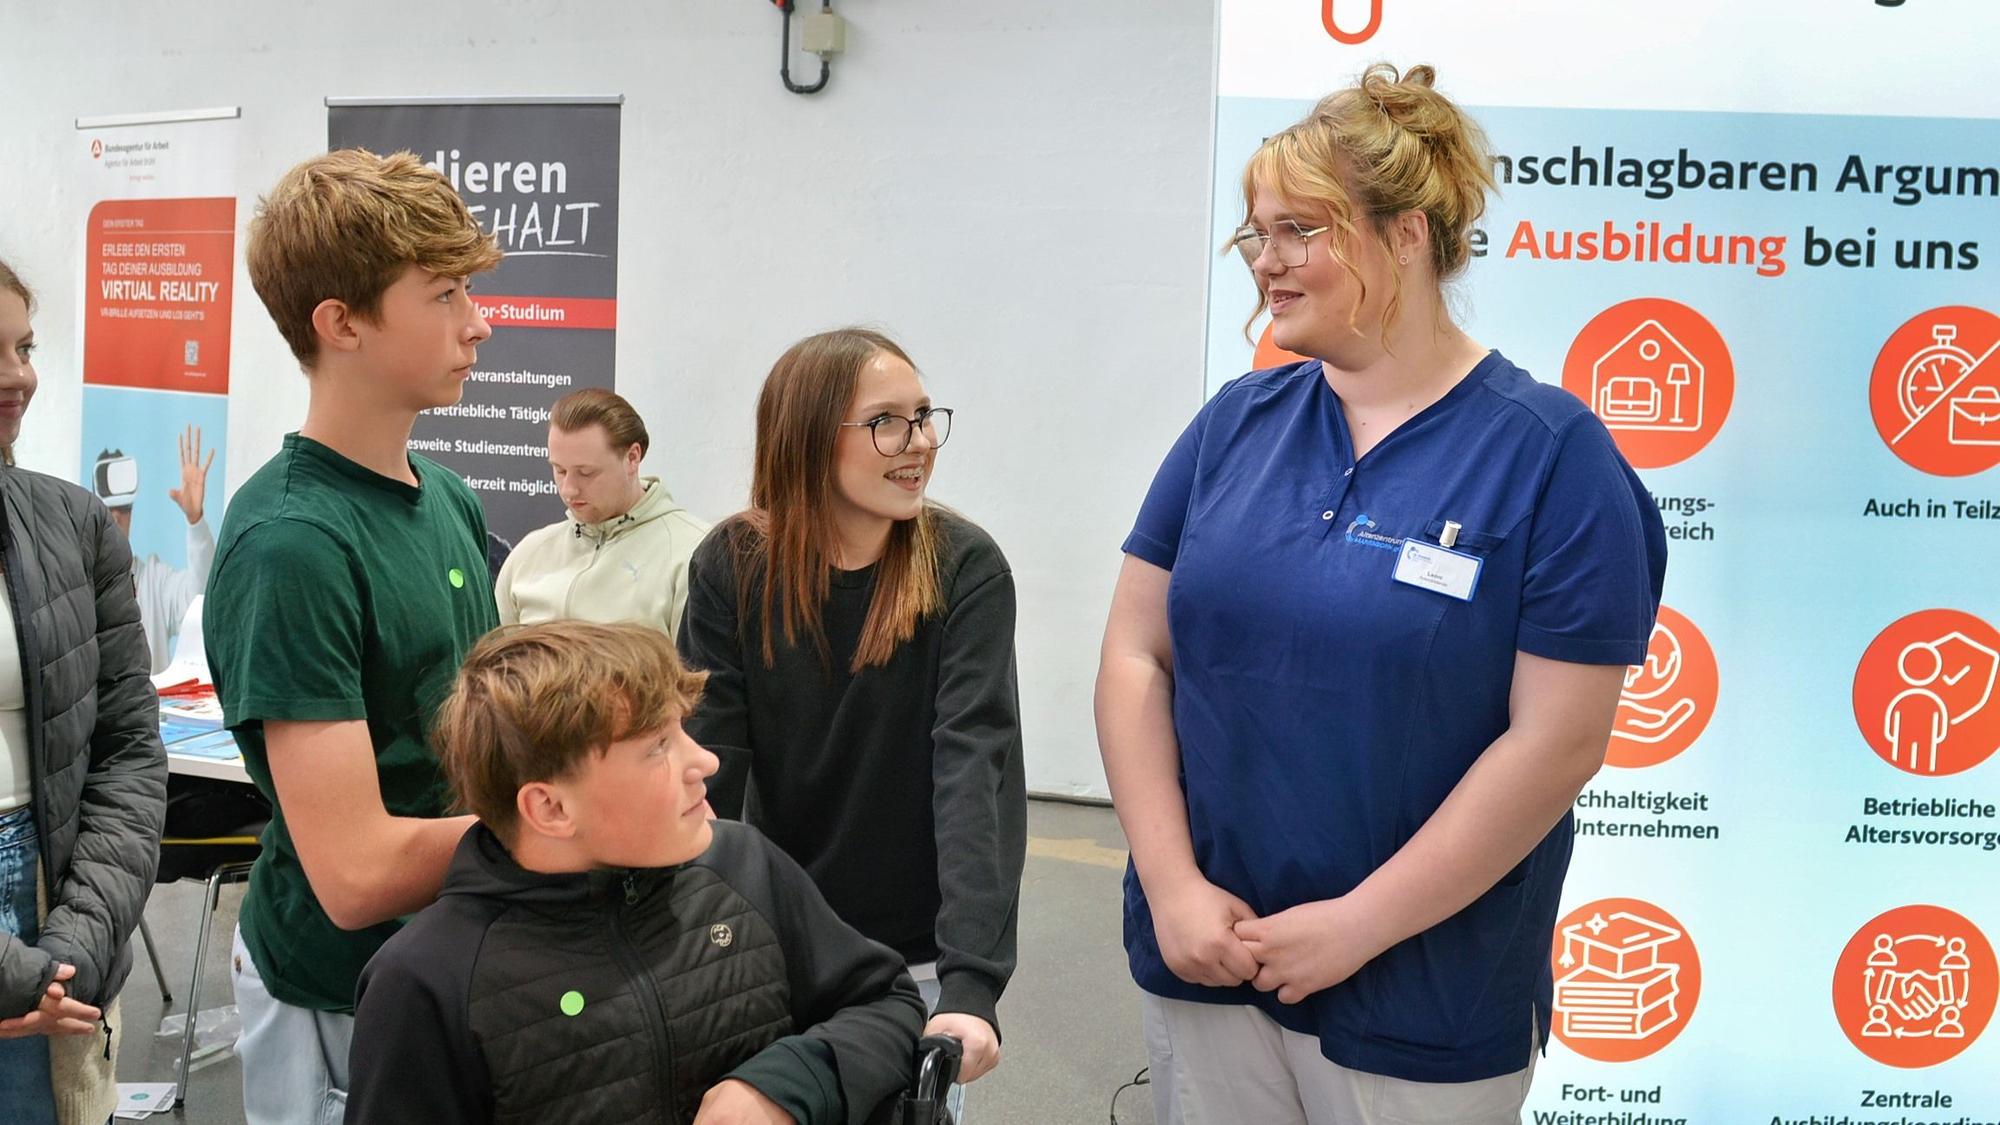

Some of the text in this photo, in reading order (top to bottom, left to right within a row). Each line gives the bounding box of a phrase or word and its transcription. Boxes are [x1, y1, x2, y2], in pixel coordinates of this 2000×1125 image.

[1835, 155, 2000, 206] Argum
[102, 243, 185, 257] ERLEBE DEN ERSTEN
[1505, 220, 1787, 277] Ausbildung
[1804, 226, 1876, 267] bei
[1895, 239, 1979, 271] uns
[102, 262, 202, 276] TAG DEINER AUSBILDUNG
[101, 279, 219, 302] VIRTUAL REALITY
[466, 370, 571, 388] veranstaltungen
[433, 403, 507, 419] betriebliche
[509, 406, 551, 424] Tätigk
[455, 439, 548, 458] Studienzentren
[509, 479, 557, 496] möglich
[1650, 493, 1715, 517] ungs-
[1863, 498, 2000, 519] Auch in Teilz
[1576, 789, 1709, 815] chhaltigkeit
[1863, 797, 1996, 818] Betriebliche
[1562, 1084, 1661, 1104] Fort- und
[1860, 1090, 1952, 1108] Zentrale
[1533, 1110, 1687, 1125] Weiterbildung
